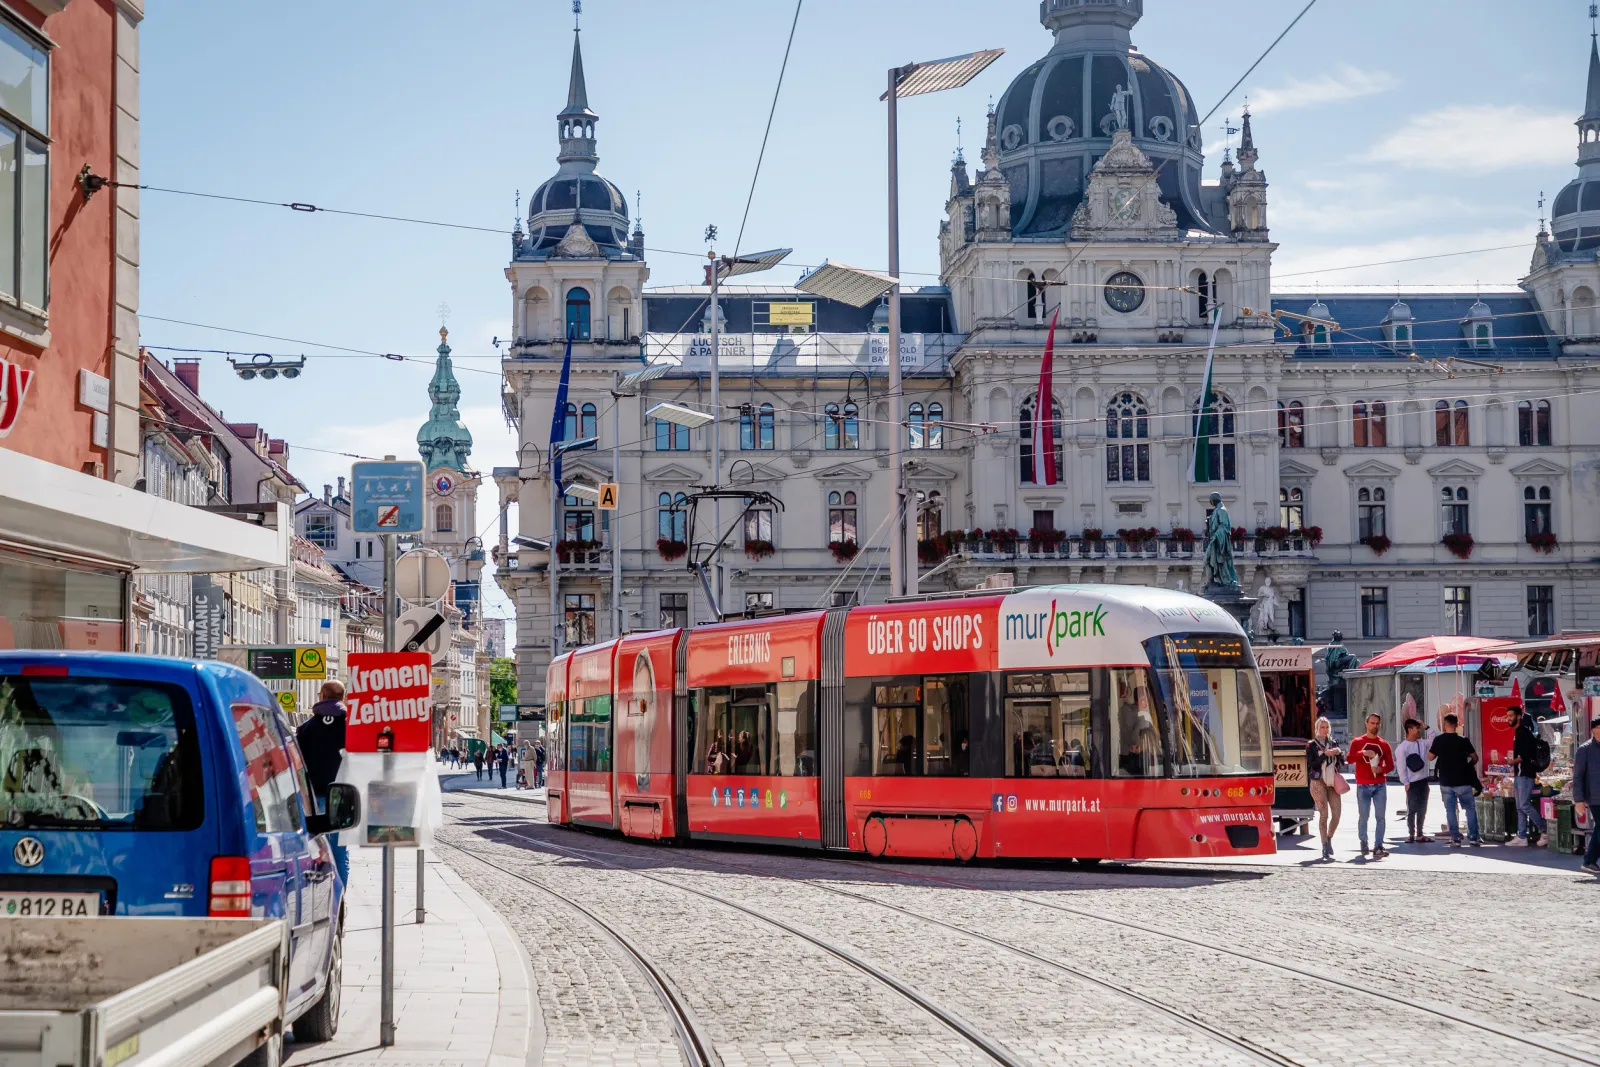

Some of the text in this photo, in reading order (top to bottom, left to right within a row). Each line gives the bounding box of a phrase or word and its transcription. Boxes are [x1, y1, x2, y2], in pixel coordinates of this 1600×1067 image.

[871, 337, 906, 345] ROLD
[871, 346, 917, 354] BEROLD
[690, 347, 746, 357] & PATNER
[602, 487, 614, 505] A
[210, 603, 221, 660] UMANIC
[867, 613, 983, 655] ÜBER 90 SHOPS
[728, 632, 771, 666] ERLEBNIS
[346, 663, 429, 694] Kronen
[347, 695, 431, 726] Zeitung
[1227, 786, 1244, 798] 668
[1025, 796, 1101, 816] www.murpark.at
[1200, 810, 1266, 824] www.murpark.at
[20, 897, 56, 916] 812
[61, 898, 88, 916] BA
